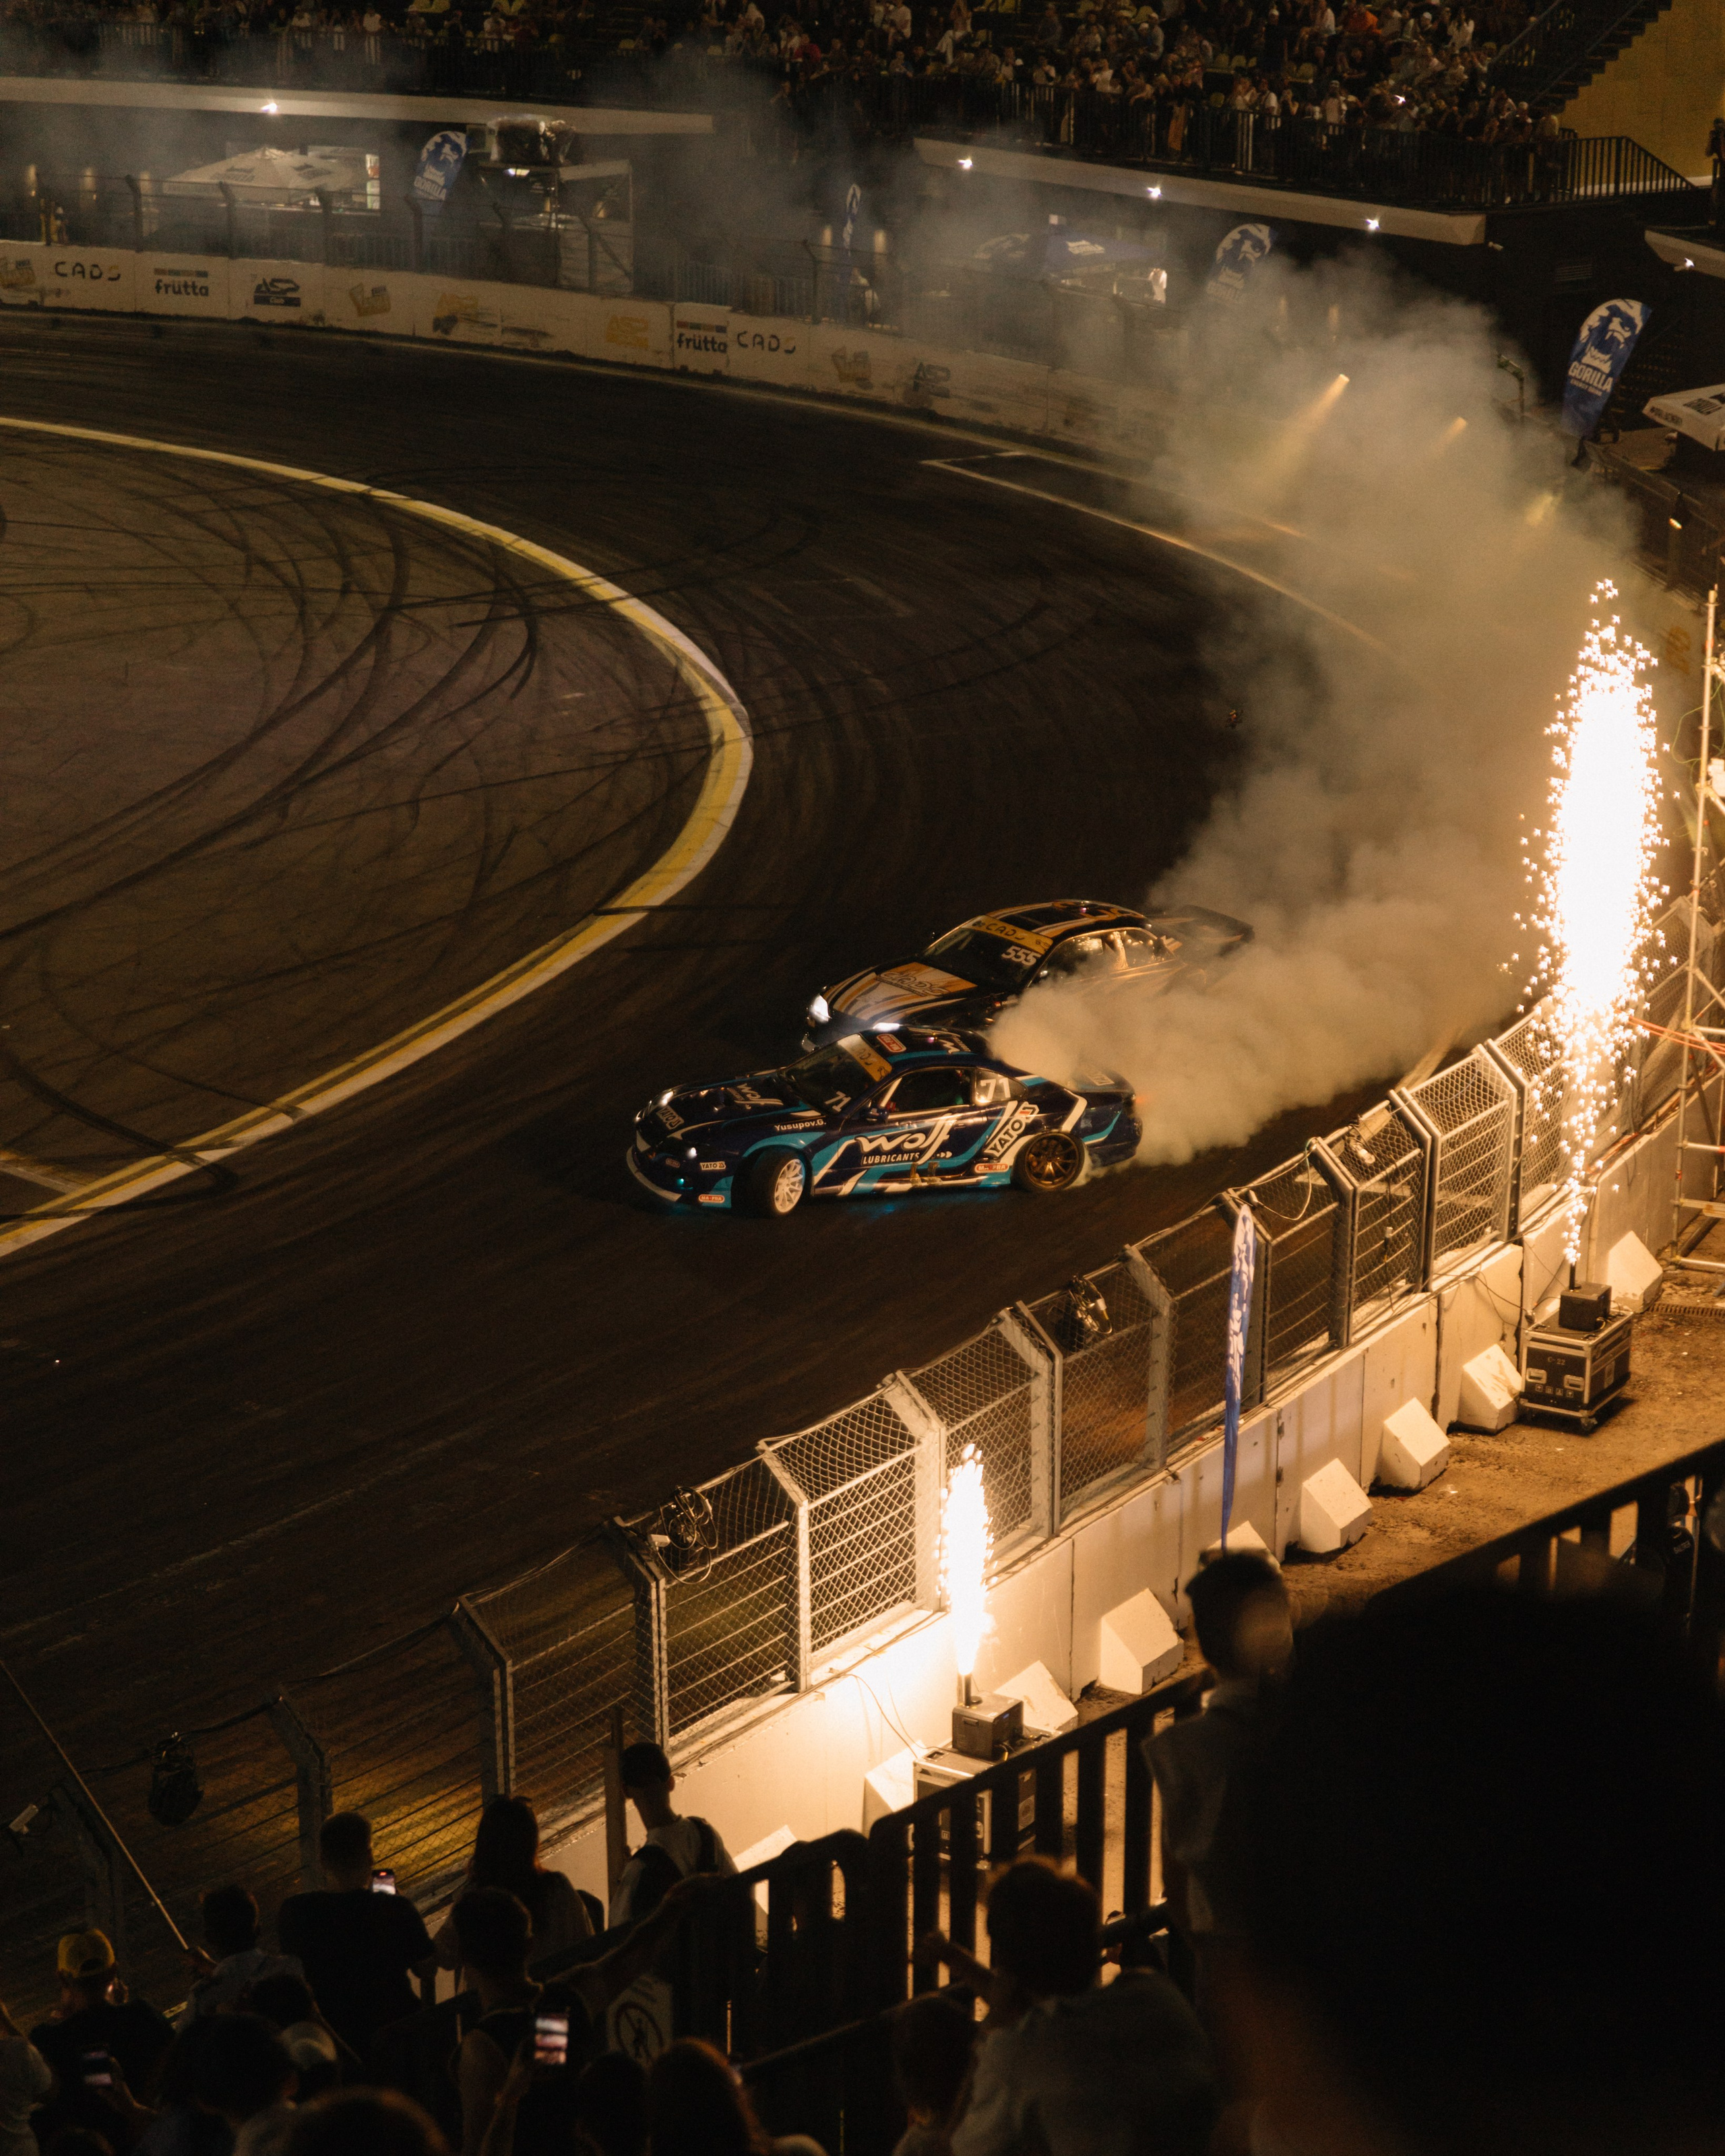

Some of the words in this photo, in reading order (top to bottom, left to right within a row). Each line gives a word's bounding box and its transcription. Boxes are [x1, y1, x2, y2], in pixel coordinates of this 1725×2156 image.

[414, 175, 447, 200] GORILLA
[1568, 361, 1613, 392] GORILLA
[1001, 945, 1042, 966] 555
[980, 1078, 1011, 1102] 71
[825, 1091, 852, 1112] 71
[775, 1118, 827, 1131] Yusupov.G.
[989, 1118, 1023, 1155] YATO
[862, 1151, 920, 1165] LUBRICANTS
